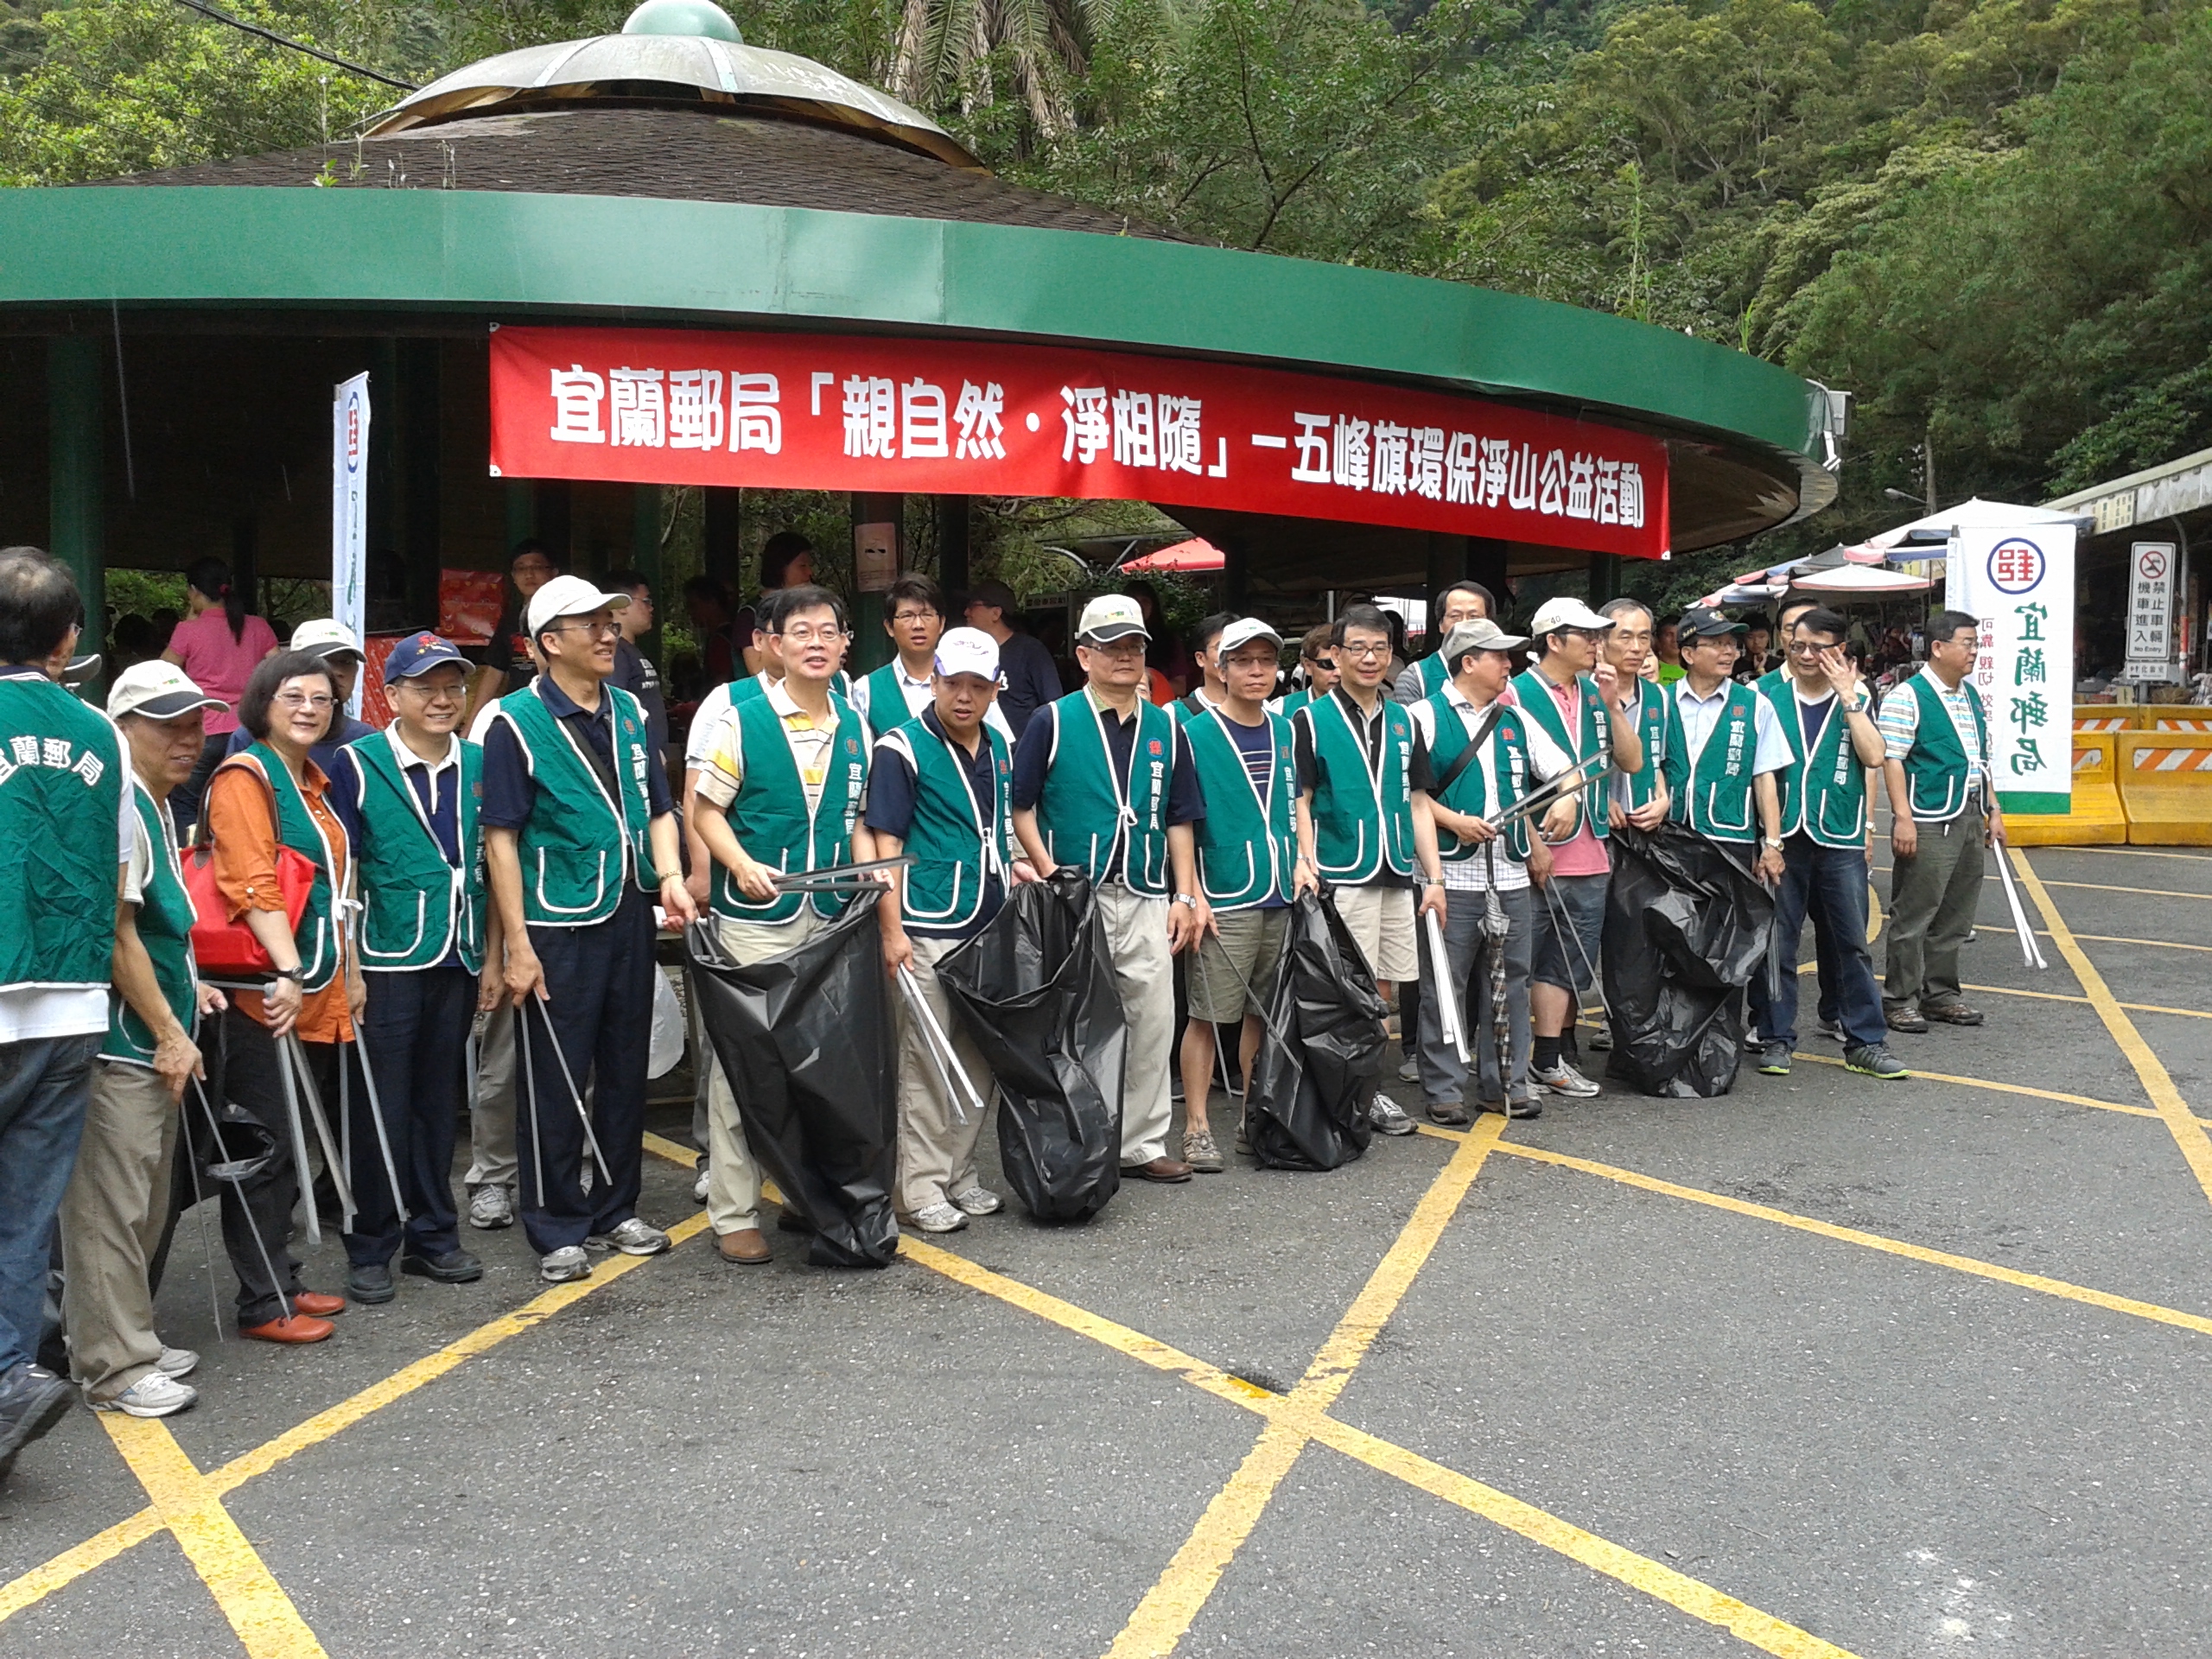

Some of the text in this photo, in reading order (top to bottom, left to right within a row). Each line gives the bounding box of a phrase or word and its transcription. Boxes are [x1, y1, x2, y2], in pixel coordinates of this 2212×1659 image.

[2133, 581, 2150, 643] 機車進入
[2150, 581, 2165, 643] 禁止車輛
[2145, 645, 2162, 654] Entry
